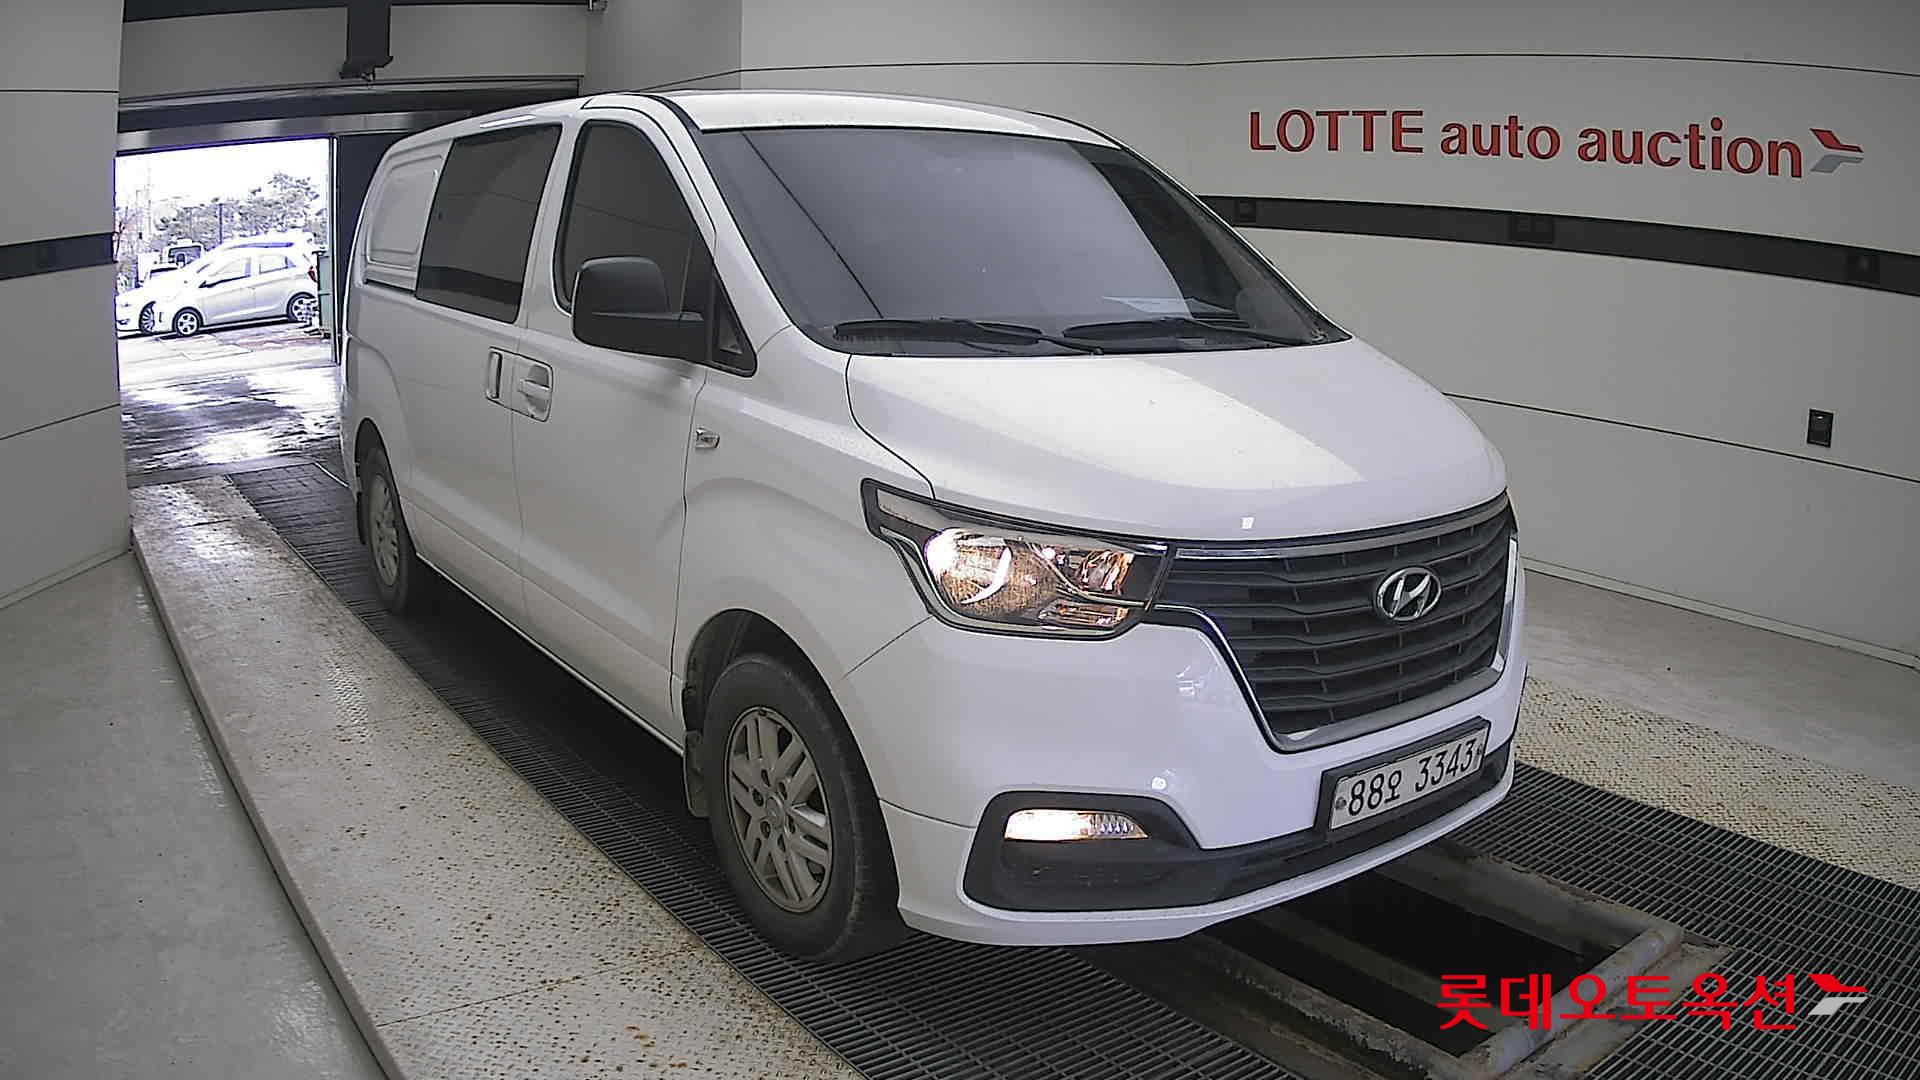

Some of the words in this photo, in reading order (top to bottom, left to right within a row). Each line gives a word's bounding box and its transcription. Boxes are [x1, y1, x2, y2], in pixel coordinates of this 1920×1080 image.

[1250, 109, 1424, 153] LOTTE
[1440, 115, 1561, 160] auto
[1577, 116, 1802, 178] auction
[1349, 770, 1402, 816] 88오
[1415, 739, 1478, 792] 3343
